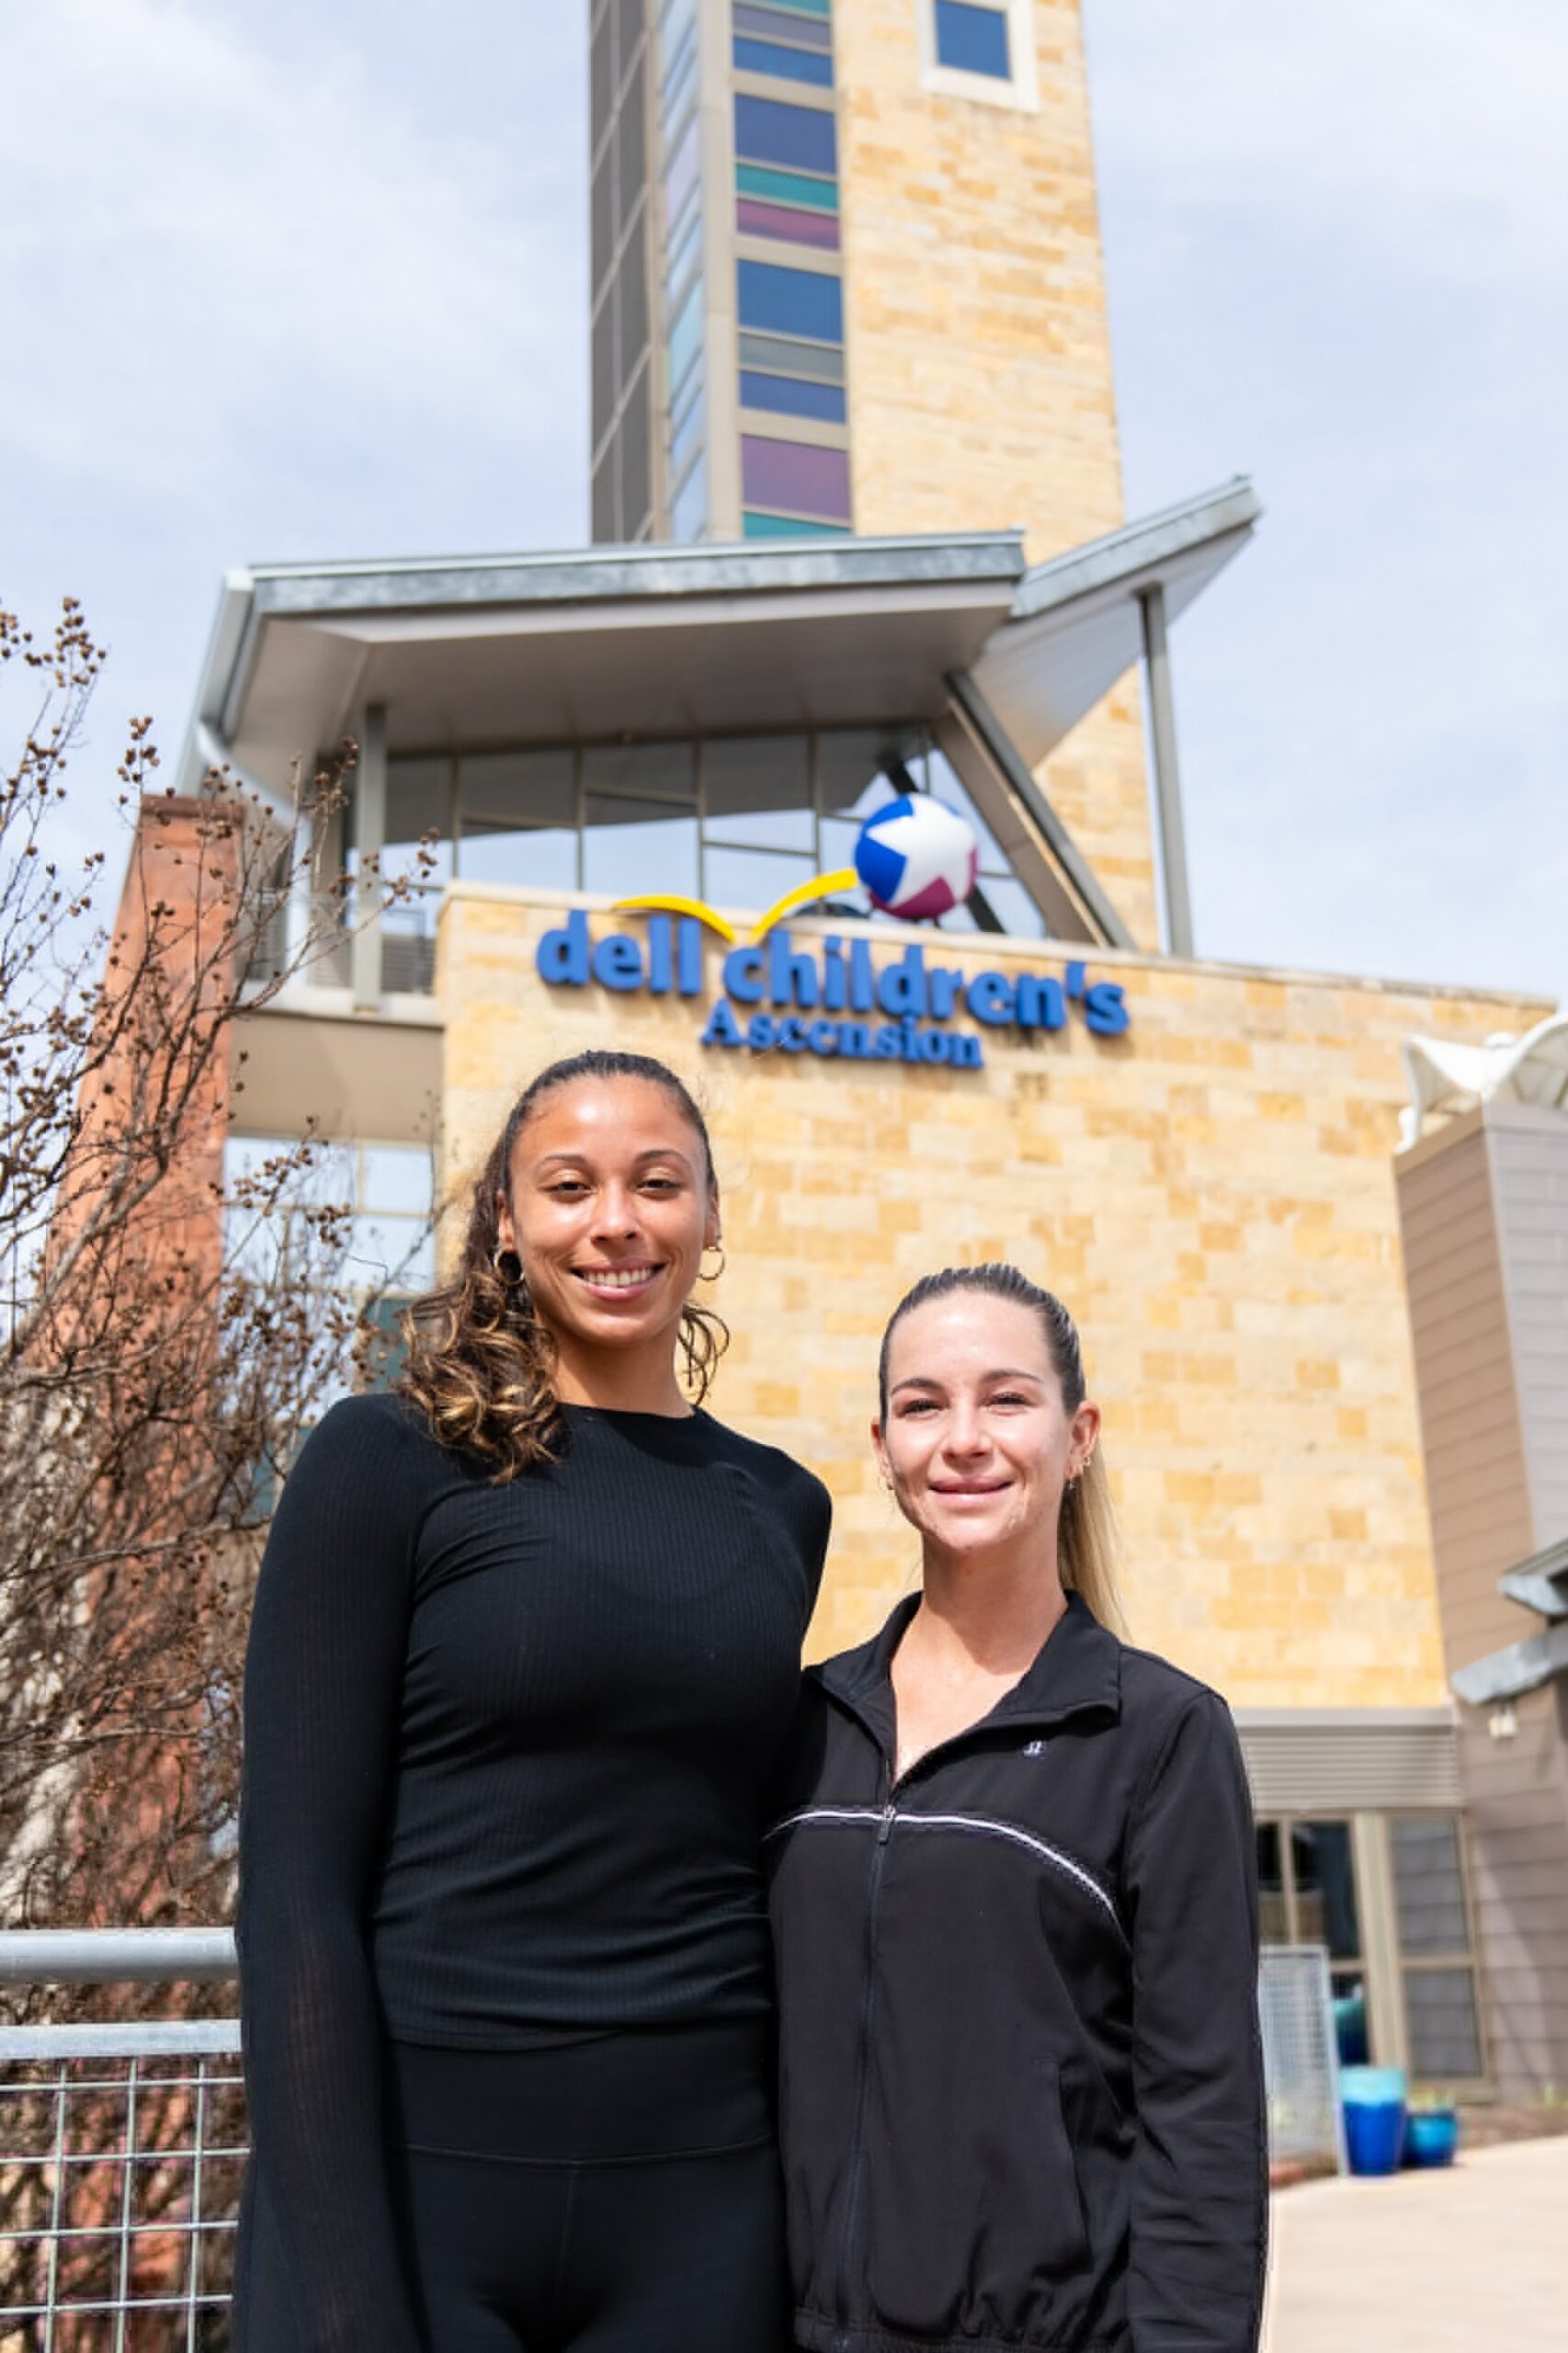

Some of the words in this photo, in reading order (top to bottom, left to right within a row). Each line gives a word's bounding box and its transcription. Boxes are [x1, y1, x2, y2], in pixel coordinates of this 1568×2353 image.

[536, 909, 703, 996] dell
[722, 928, 1129, 1036] children's
[699, 998, 984, 1069] Ascension
